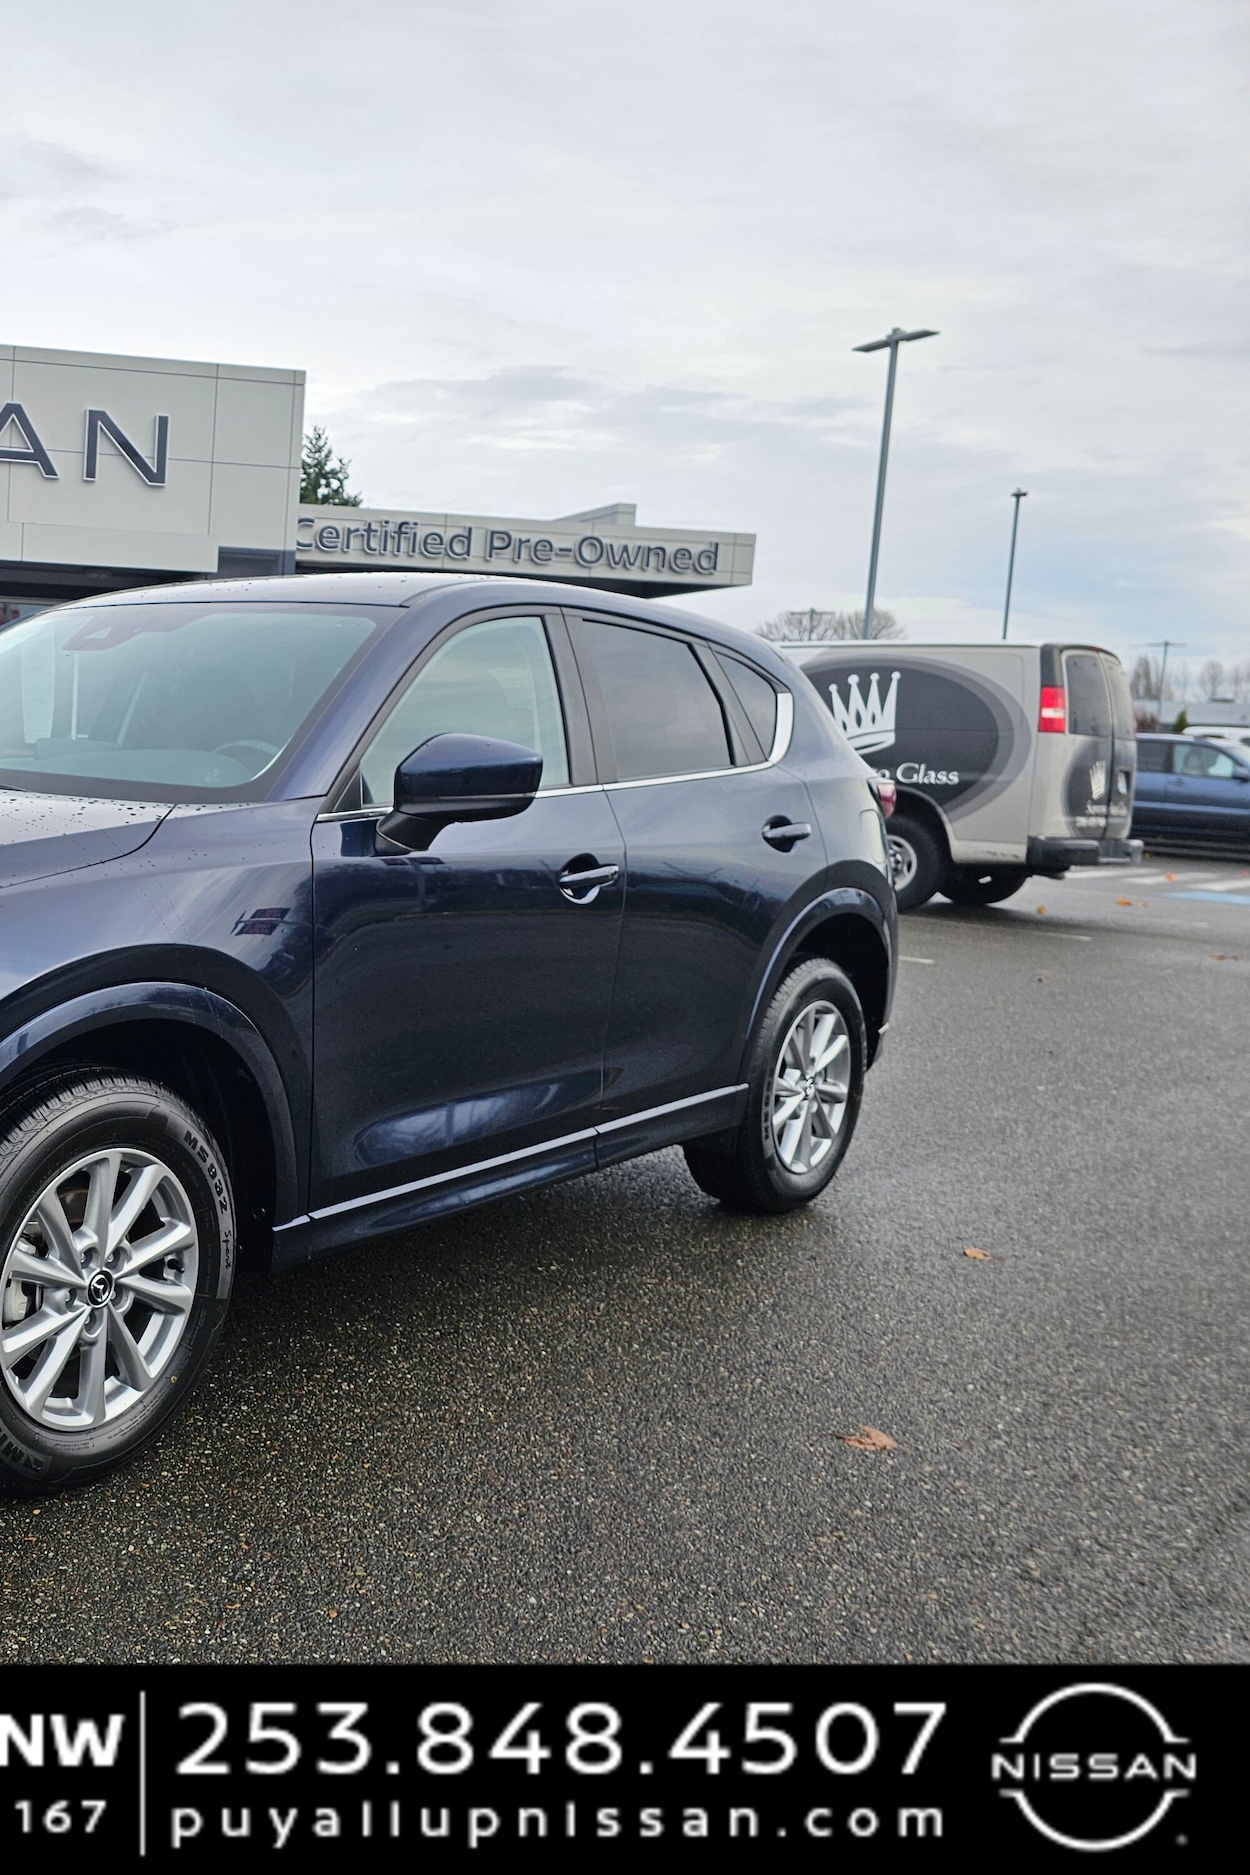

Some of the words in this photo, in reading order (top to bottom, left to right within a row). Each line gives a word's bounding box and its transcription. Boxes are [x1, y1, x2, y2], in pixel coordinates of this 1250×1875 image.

[297, 518, 473, 559] Certified
[485, 529, 719, 574] Pre-Owned
[896, 762, 960, 785] Glass
[183, 1130, 228, 1214] MS932
[222, 1229, 232, 1270] Sport
